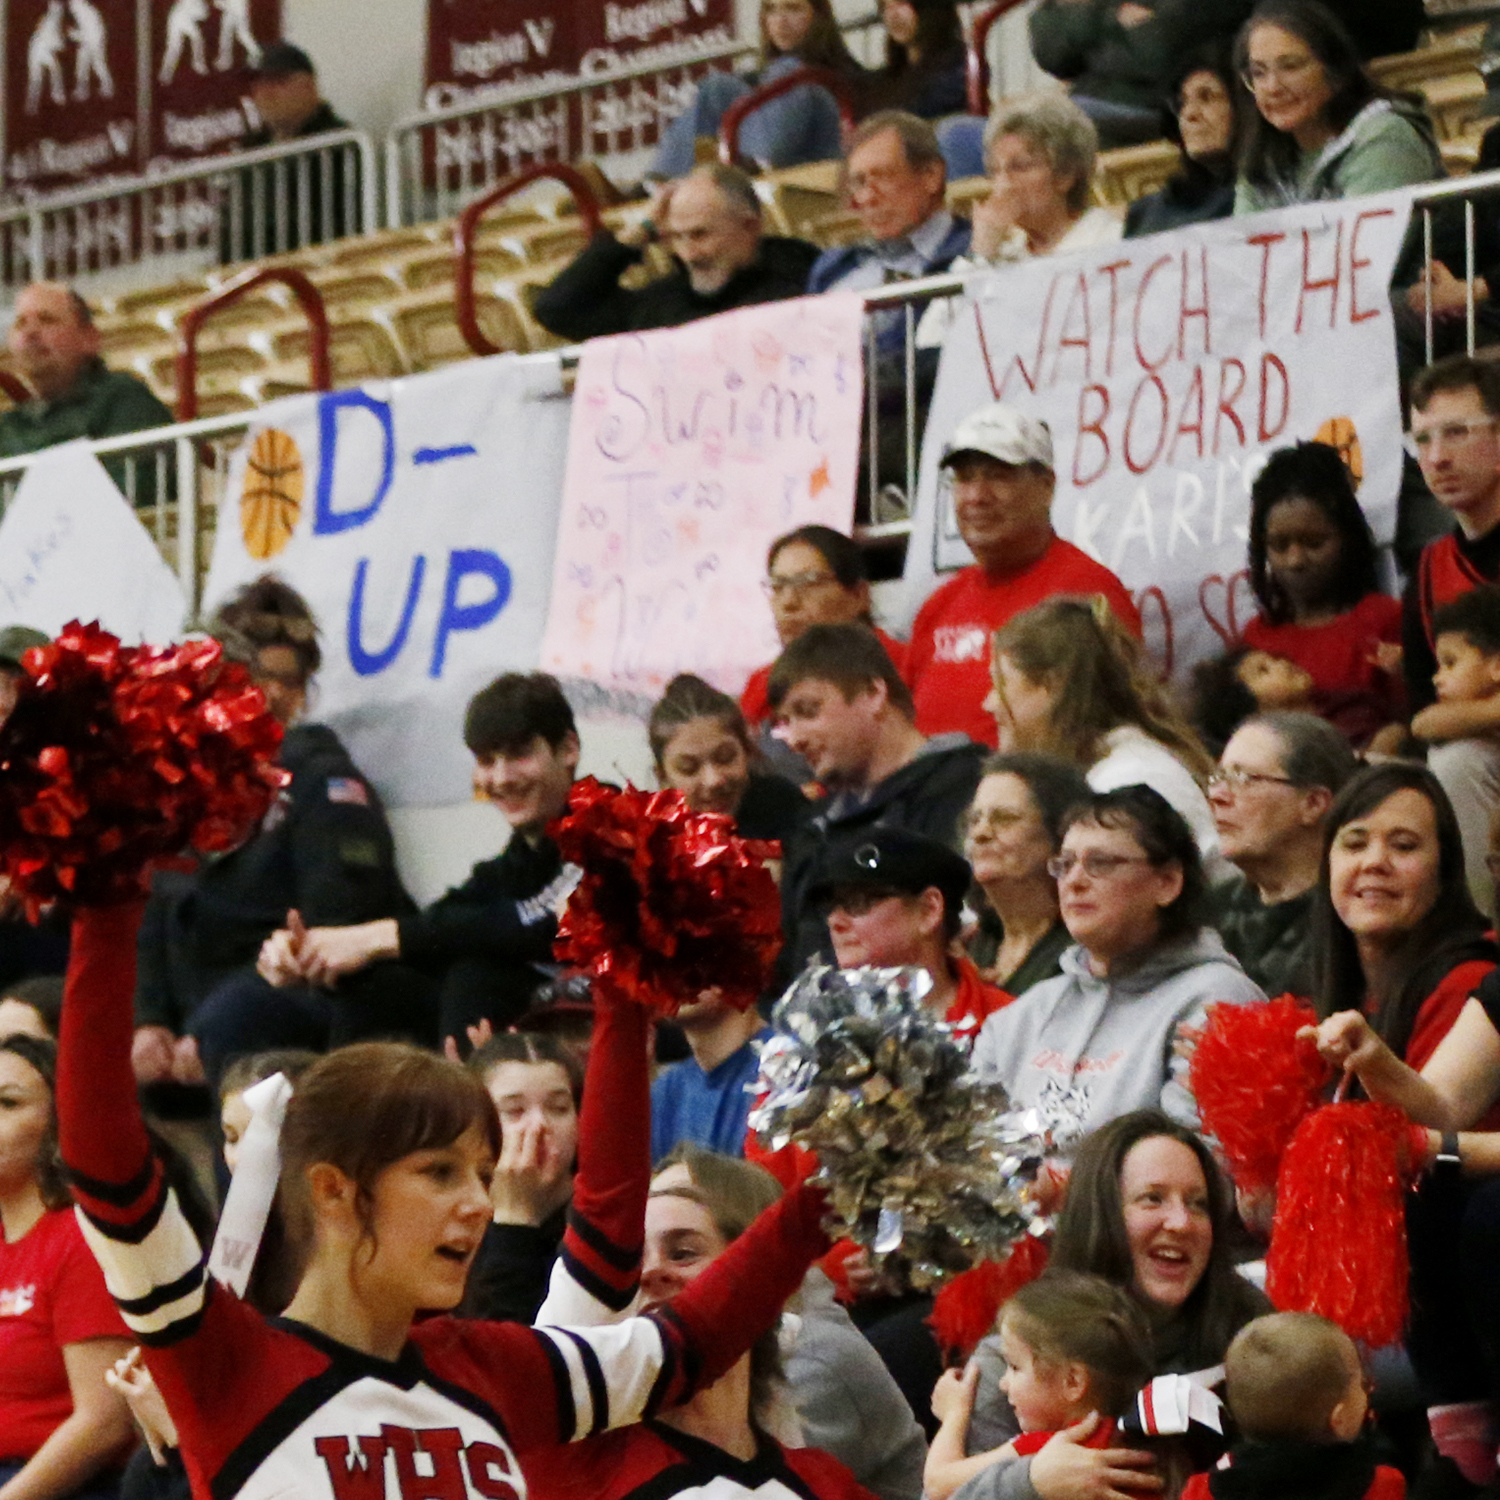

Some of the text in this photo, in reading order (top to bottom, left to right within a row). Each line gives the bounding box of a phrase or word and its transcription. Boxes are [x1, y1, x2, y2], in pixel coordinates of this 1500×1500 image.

[973, 209, 1395, 401] WATCH THE
[313, 387, 477, 536] D-
[595, 333, 824, 463] Swim
[1072, 352, 1290, 488] BOARD
[347, 547, 513, 678] UP
